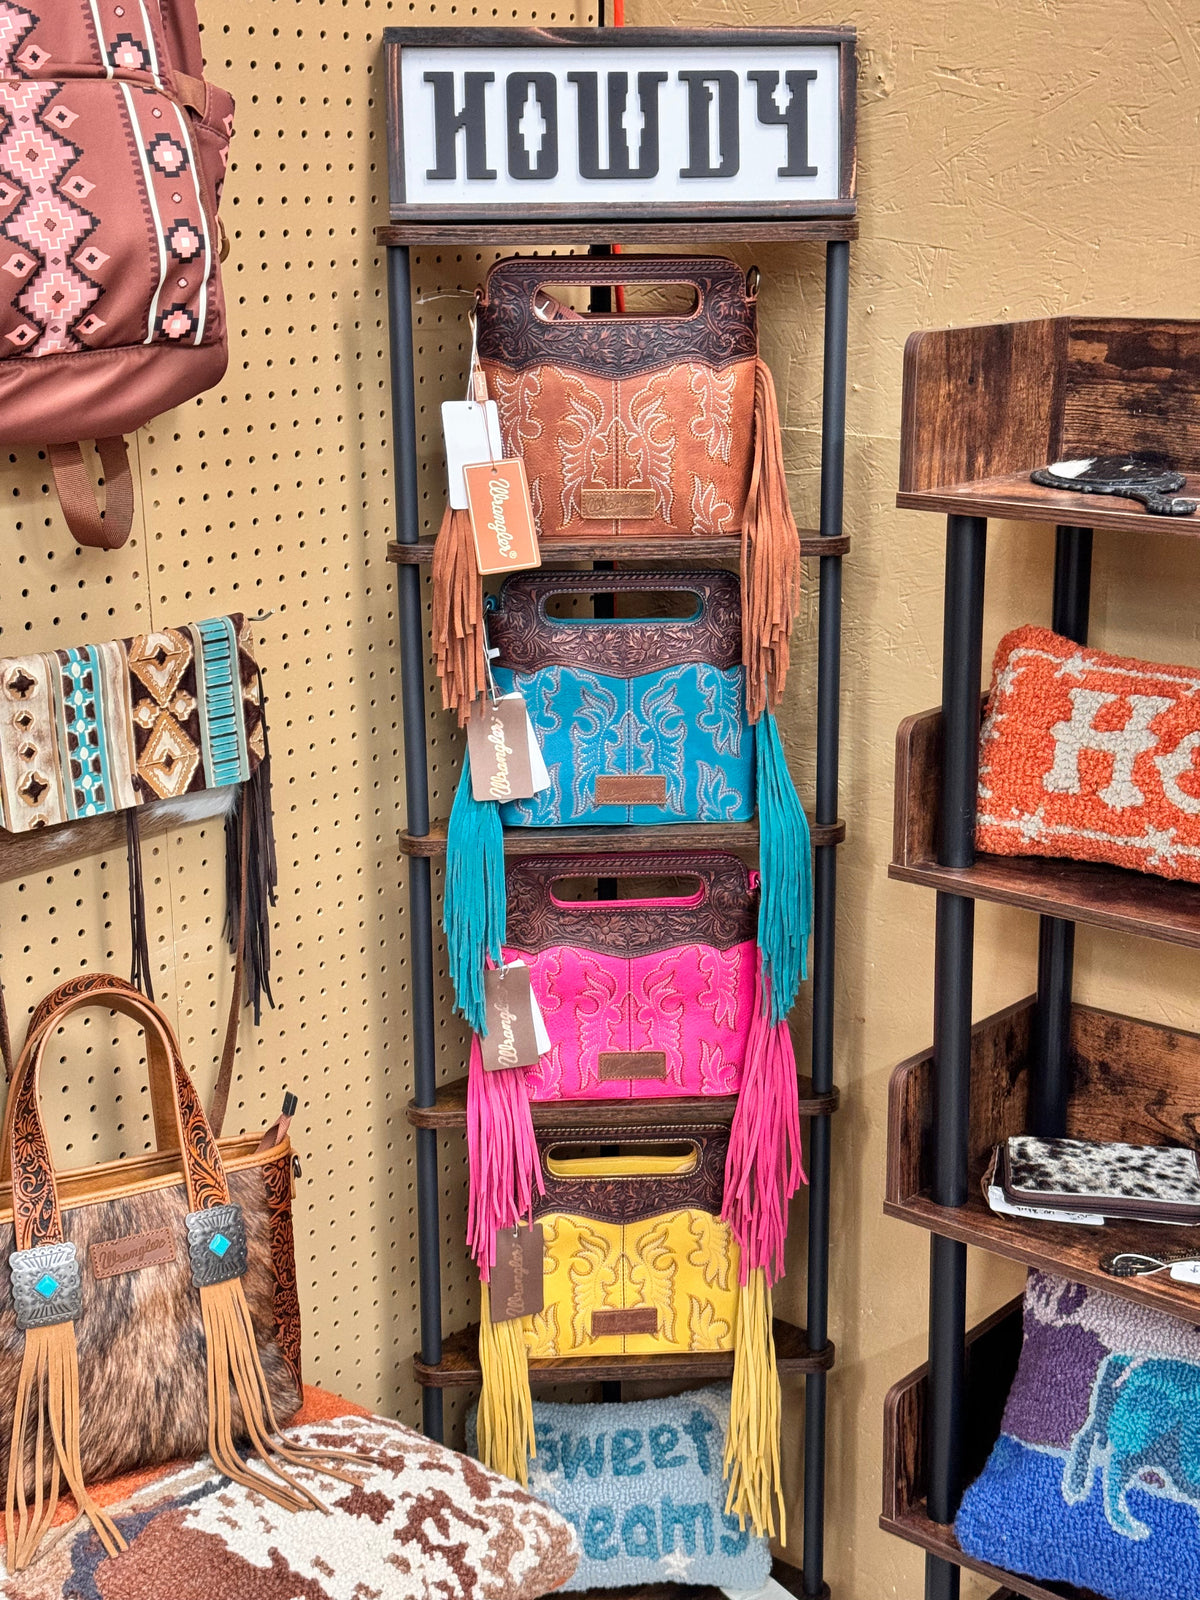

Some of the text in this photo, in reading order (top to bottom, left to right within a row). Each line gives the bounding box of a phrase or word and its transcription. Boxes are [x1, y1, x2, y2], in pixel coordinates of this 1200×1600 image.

[423, 70, 818, 179] HOWDY
[487, 477, 513, 558] Wrangler
[487, 719, 513, 798] Wrangler
[99, 1238, 167, 1269] Wrangler
[506, 1245, 529, 1316] Wrangler
[563, 1496, 750, 1561] eams
